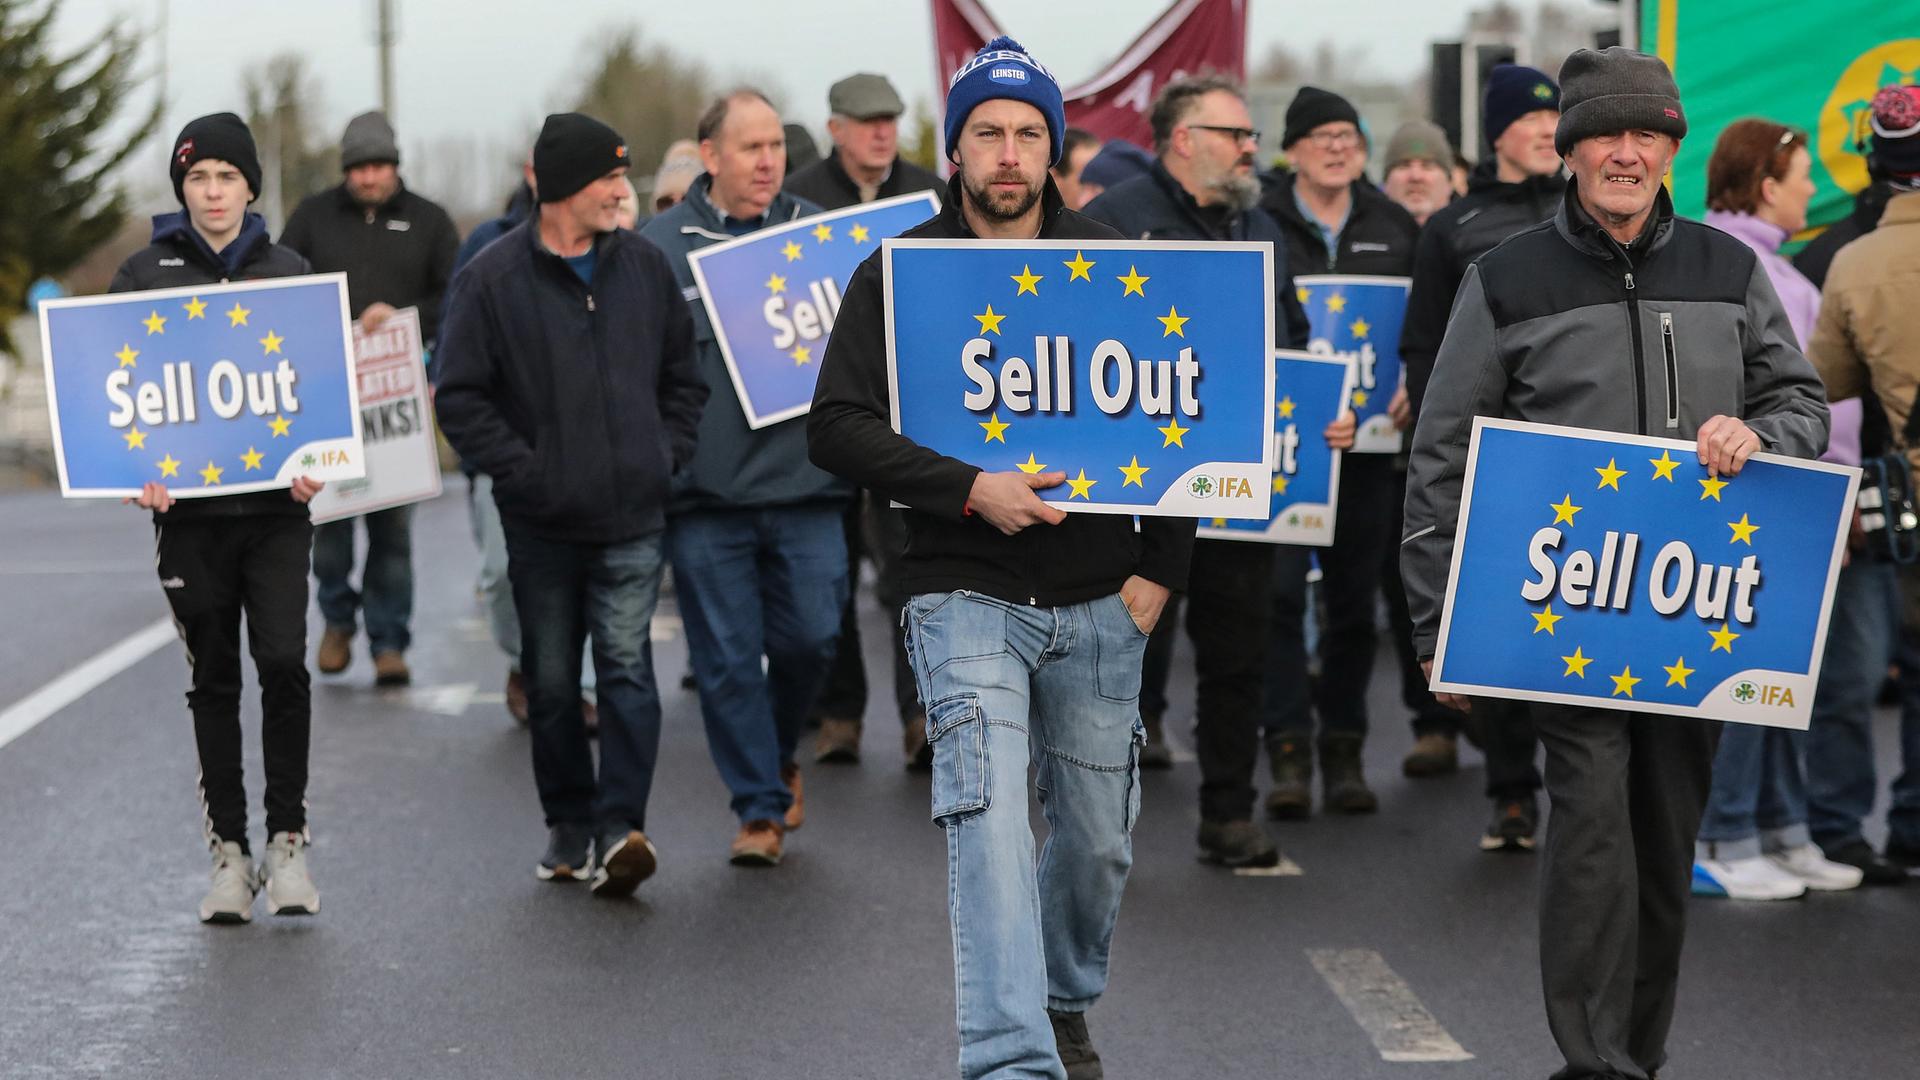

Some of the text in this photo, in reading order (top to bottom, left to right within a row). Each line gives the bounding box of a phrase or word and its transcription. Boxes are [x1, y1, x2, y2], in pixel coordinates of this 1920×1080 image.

[992, 68, 1025, 80] LEINSTER
[763, 276, 843, 350] Sell
[105, 358, 299, 428] Sell Out
[962, 335, 1199, 417] Sell Out
[321, 450, 349, 467] IFA
[1219, 477, 1253, 498] IFA
[1520, 527, 1761, 624] Sell Out
[1760, 685, 1796, 708] IFA
